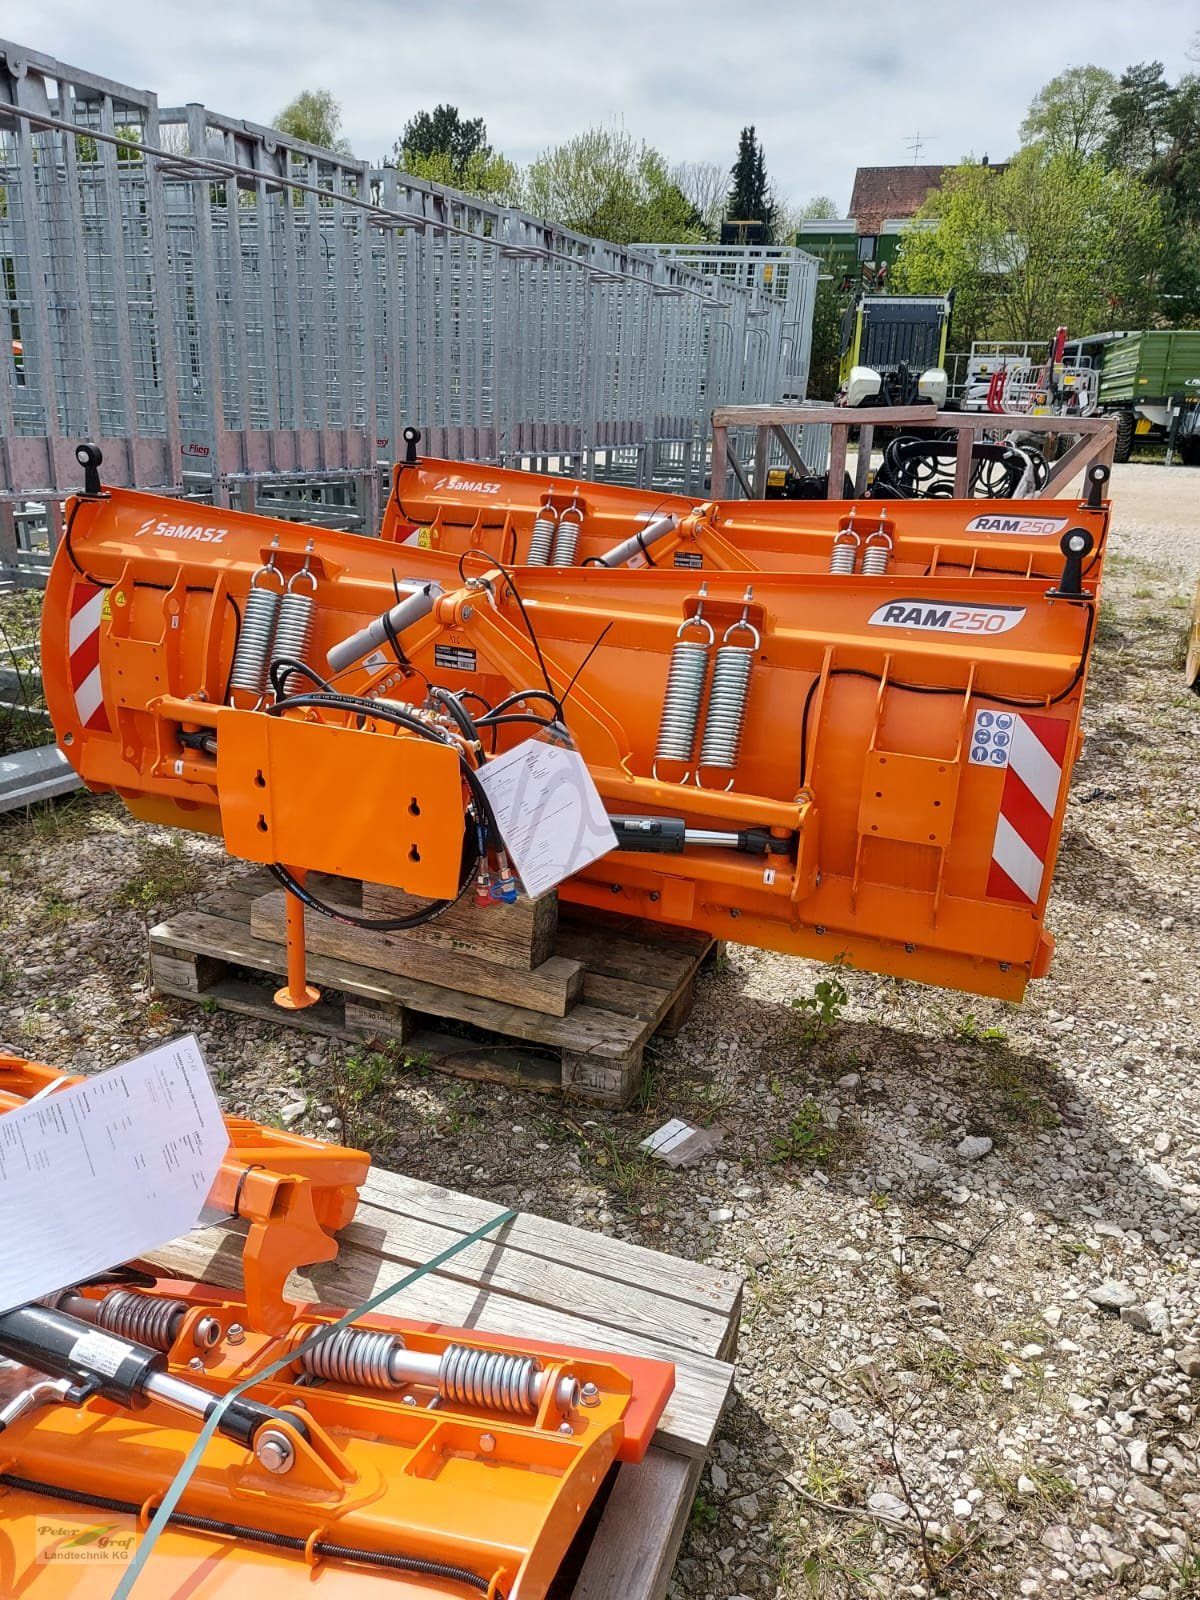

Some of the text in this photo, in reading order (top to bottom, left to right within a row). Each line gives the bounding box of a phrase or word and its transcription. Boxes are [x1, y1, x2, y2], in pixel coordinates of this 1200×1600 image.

[446, 480, 501, 493] SaMASZ
[152, 522, 229, 543] SaMASZ
[882, 605, 1006, 632] RAM250
